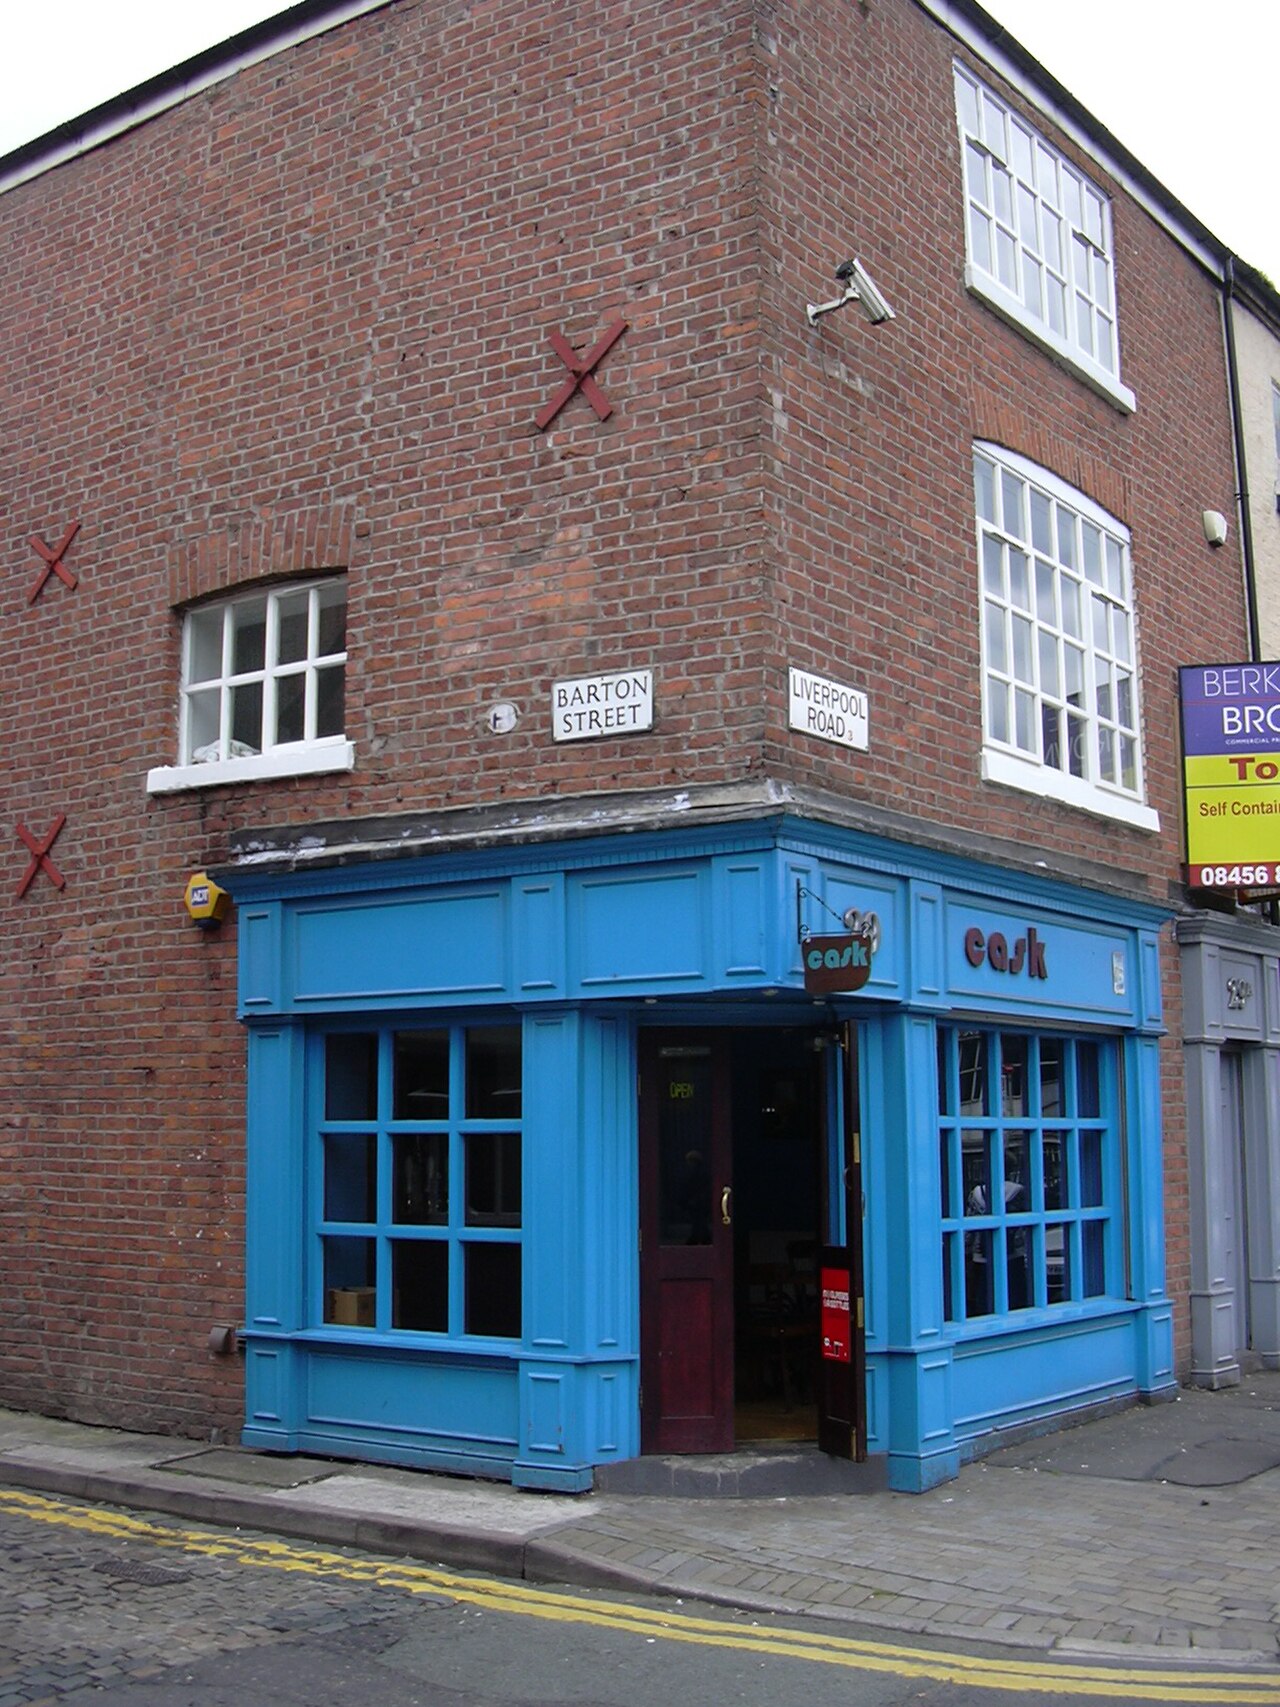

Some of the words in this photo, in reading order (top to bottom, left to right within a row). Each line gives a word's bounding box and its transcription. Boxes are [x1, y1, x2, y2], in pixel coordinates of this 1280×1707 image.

[558, 676, 647, 708] BARTON
[793, 674, 865, 720] LIVERPOOL
[563, 704, 642, 734] STREET
[808, 706, 845, 737] ROAD
[1229, 757, 1279, 780] To
[1200, 801, 1227, 817] Self
[1201, 865, 1269, 886] 08456
[808, 941, 868, 970] cask
[965, 927, 1048, 979] cask
